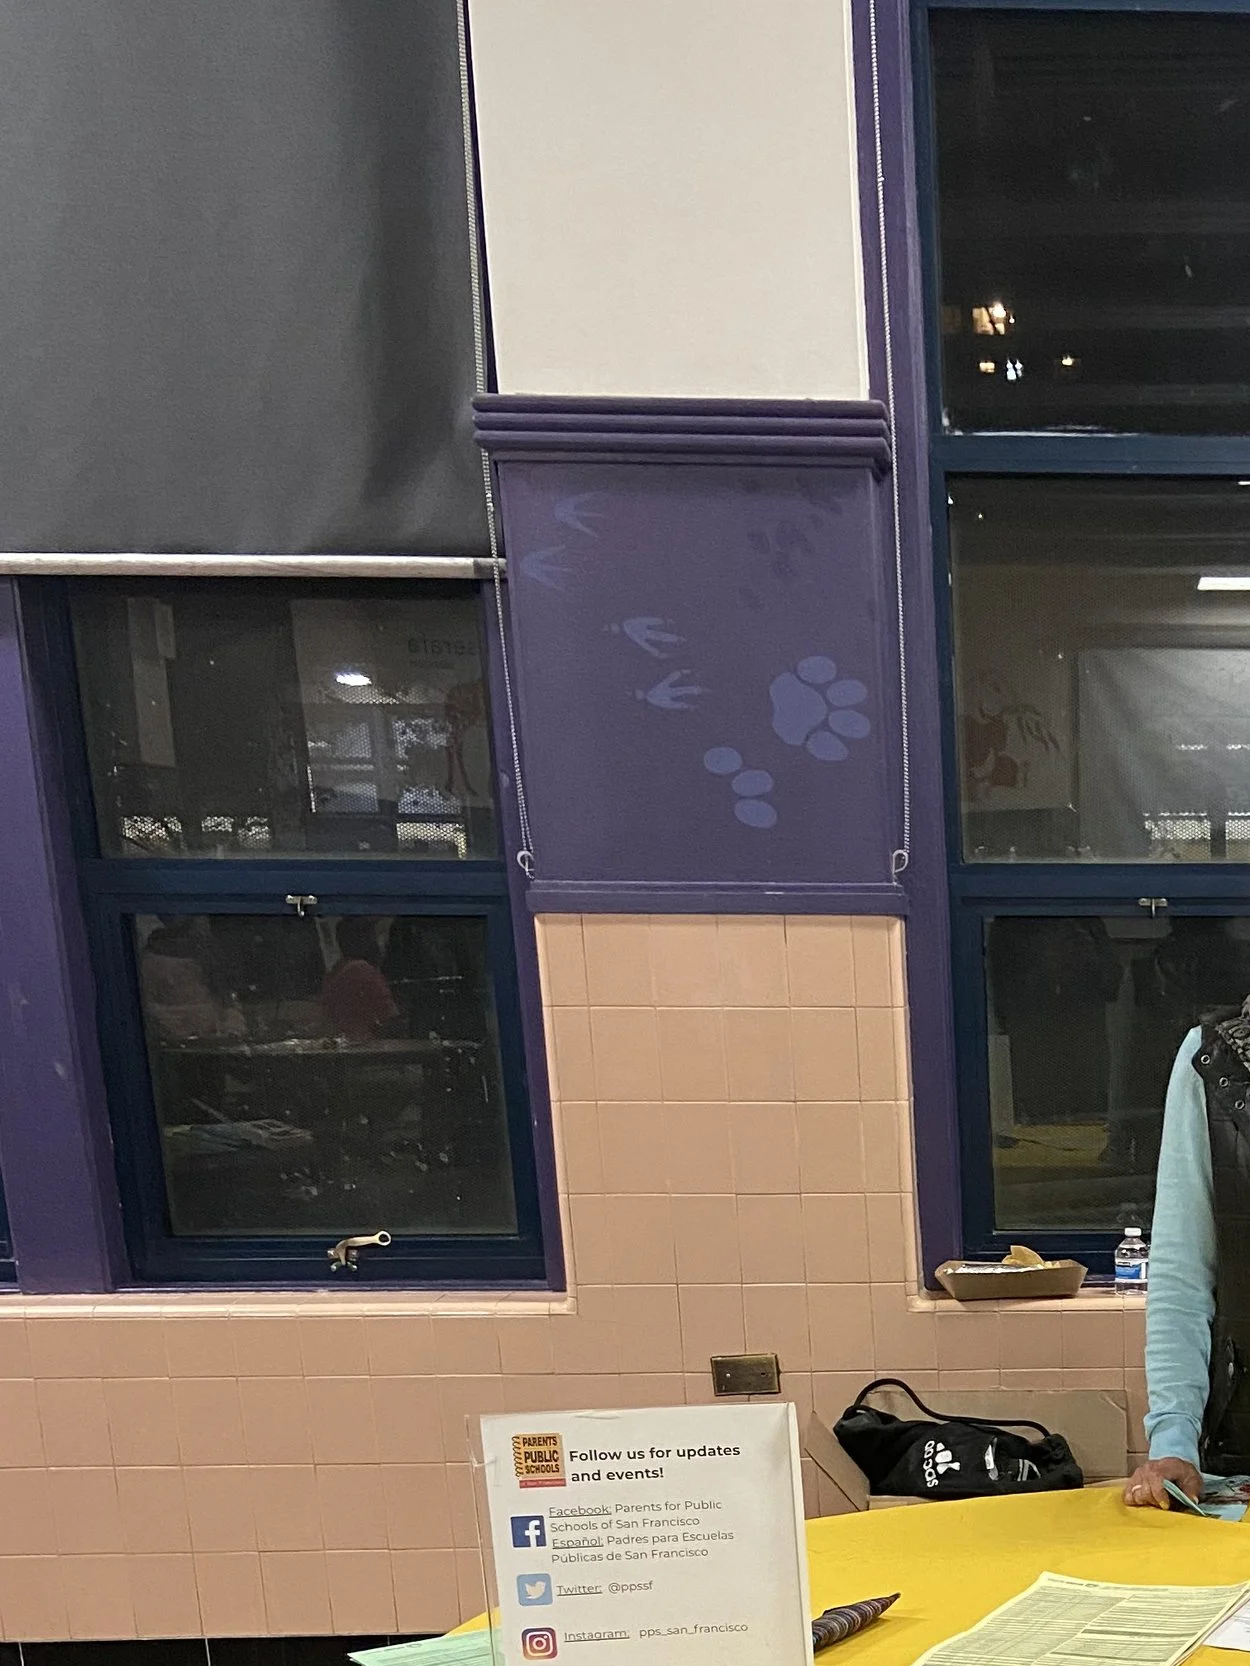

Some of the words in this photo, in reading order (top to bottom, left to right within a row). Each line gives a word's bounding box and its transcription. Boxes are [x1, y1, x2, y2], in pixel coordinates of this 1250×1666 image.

[522, 1436, 558, 1447] PARENTS
[524, 1450, 559, 1463] PUBLIC
[569, 1449, 622, 1462] Follow
[627, 1450, 645, 1460] us
[650, 1447, 672, 1459] for
[676, 1445, 741, 1460] updates
[525, 1464, 560, 1474] SCHOOLS
[571, 1470, 601, 1482] and
[606, 1467, 664, 1481] events!
[549, 1505, 612, 1517] Facebook:
[615, 1502, 662, 1513] Parents
[664, 1501, 681, 1511] for
[684, 1500, 722, 1511] Public
[550, 1521, 598, 1533] Schools
[601, 1519, 614, 1529] of
[615, 1519, 639, 1529] San
[642, 1516, 700, 1528] Francisco
[552, 1536, 604, 1549] Español:
[607, 1534, 649, 1545] Padres
[652, 1533, 679, 1546] para
[682, 1530, 734, 1542] Escuelas
[551, 1551, 603, 1563] Públicas
[606, 1551, 622, 1561] de
[625, 1550, 648, 1560] San
[651, 1547, 709, 1559] Francisco
[556, 1585, 603, 1596] Twitter:
[608, 1580, 653, 1594] @ppssf
[564, 1629, 630, 1642] Instagram:
[639, 1623, 749, 1639] pps_san_francisco
